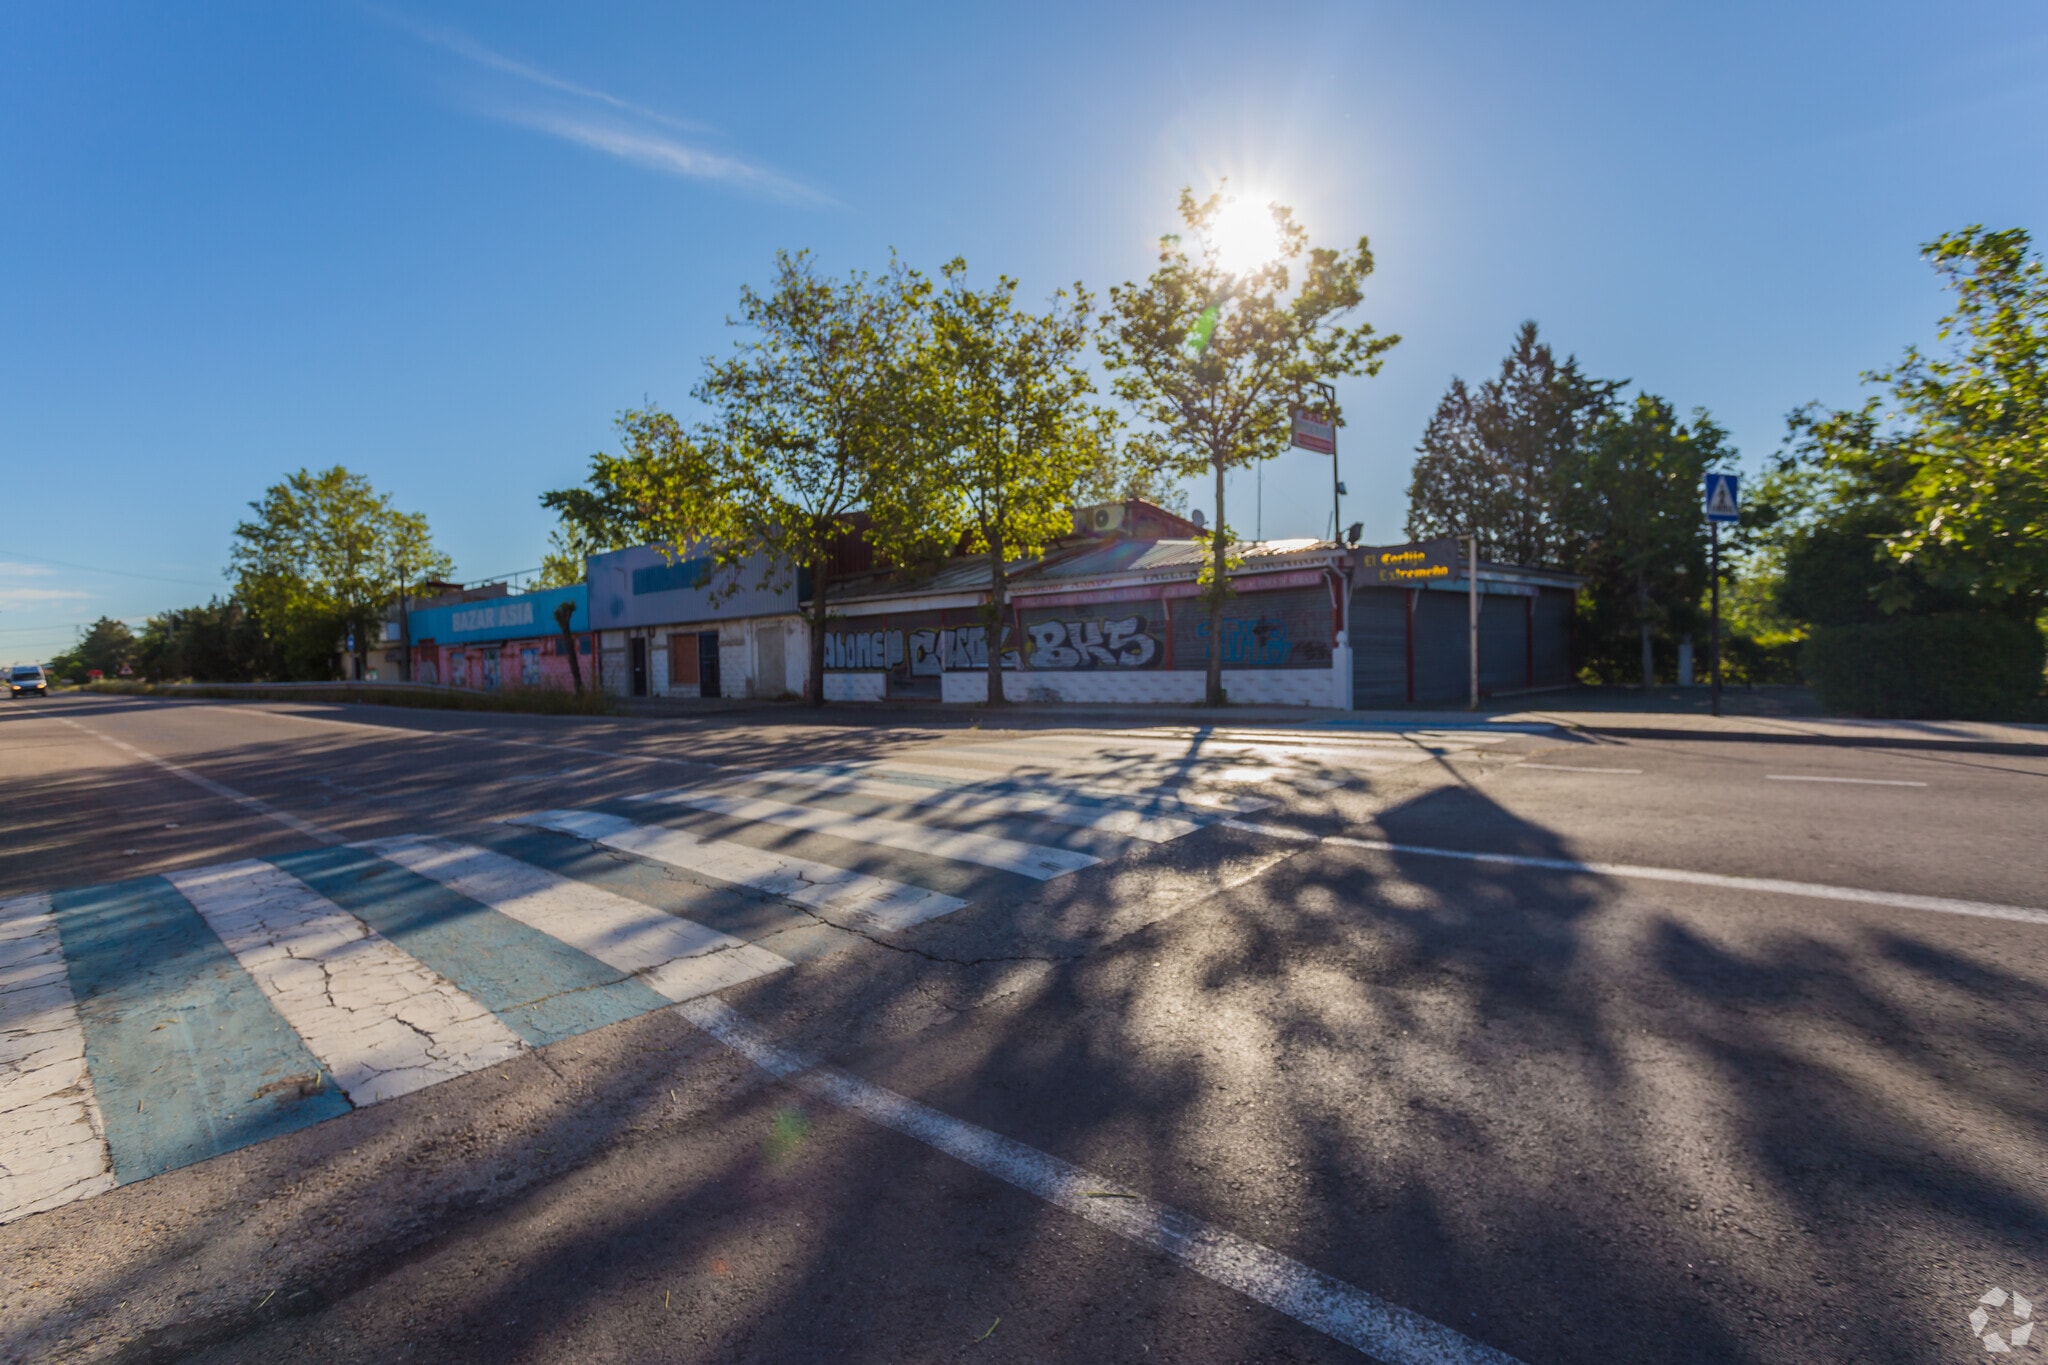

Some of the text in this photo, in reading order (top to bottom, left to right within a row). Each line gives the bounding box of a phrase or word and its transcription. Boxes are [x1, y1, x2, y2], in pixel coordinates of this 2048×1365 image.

[1381, 550, 1426, 566] Cortijo
[1379, 564, 1449, 582] Extremeño
[452, 602, 534, 632] BAZAR ASIA
